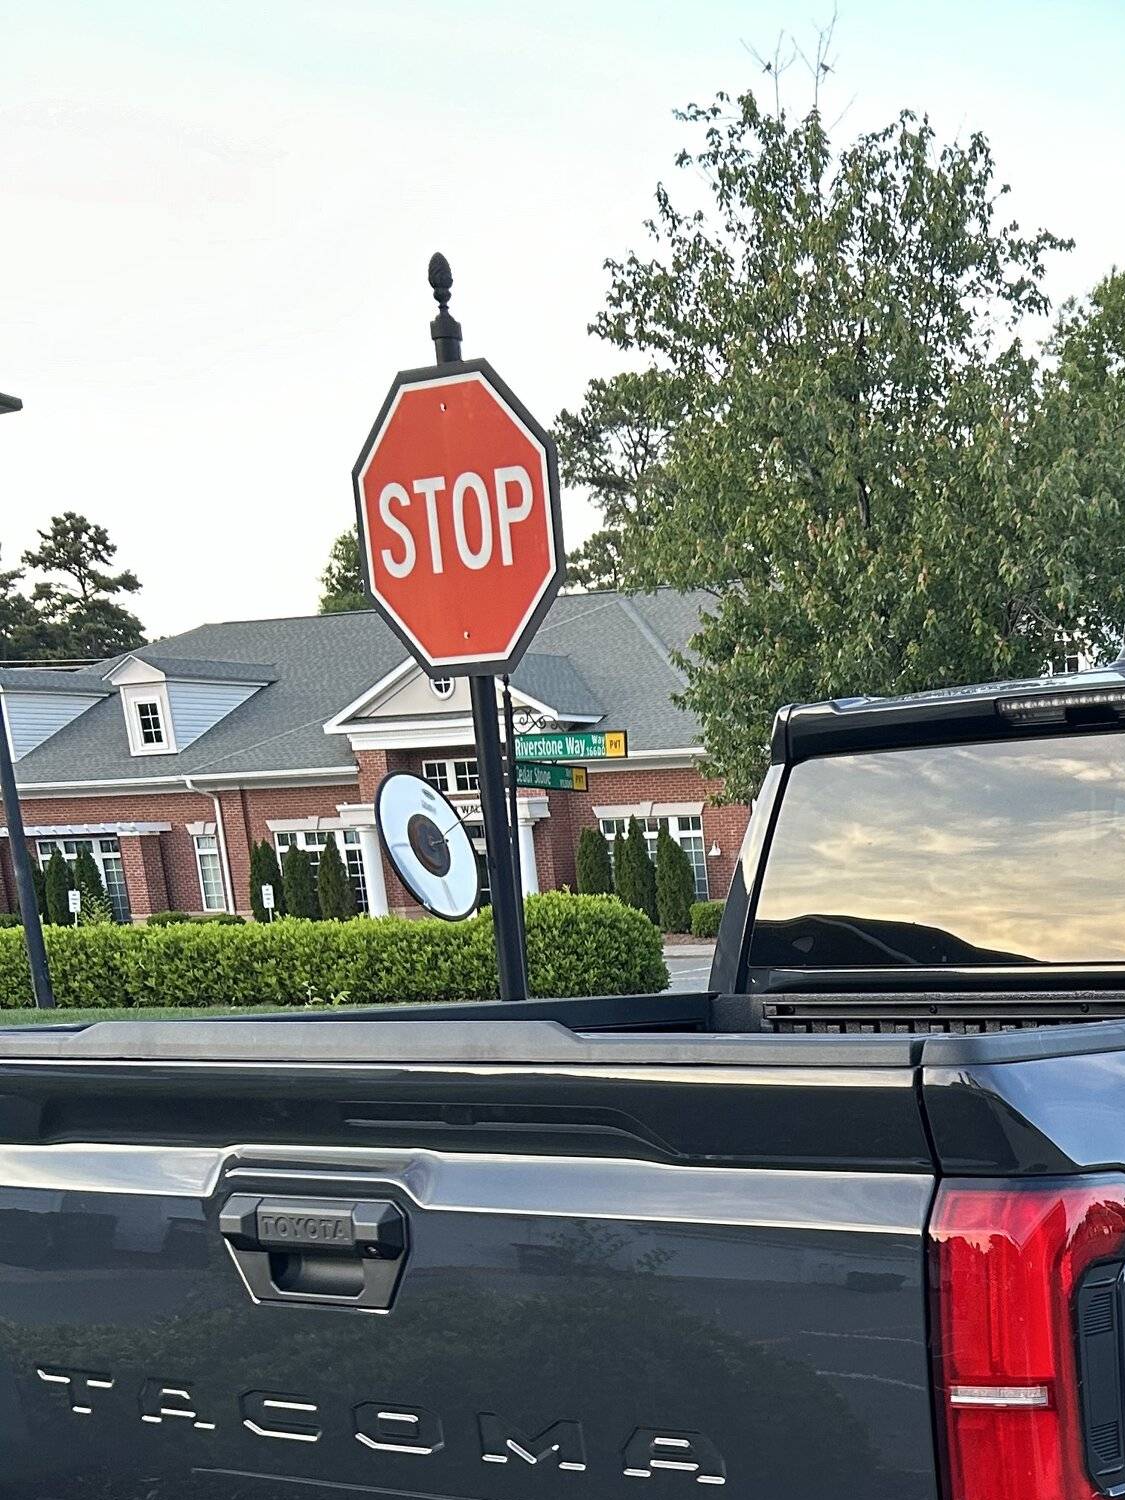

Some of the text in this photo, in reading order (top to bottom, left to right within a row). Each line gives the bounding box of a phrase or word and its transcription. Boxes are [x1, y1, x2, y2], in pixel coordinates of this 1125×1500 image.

[379, 465, 533, 579] STOP
[515, 737, 585, 757] Riverstone Way
[609, 740, 621, 749] PVT
[261, 1215, 350, 1241] TOYOTA
[35, 1366, 727, 1485] TACOMA
